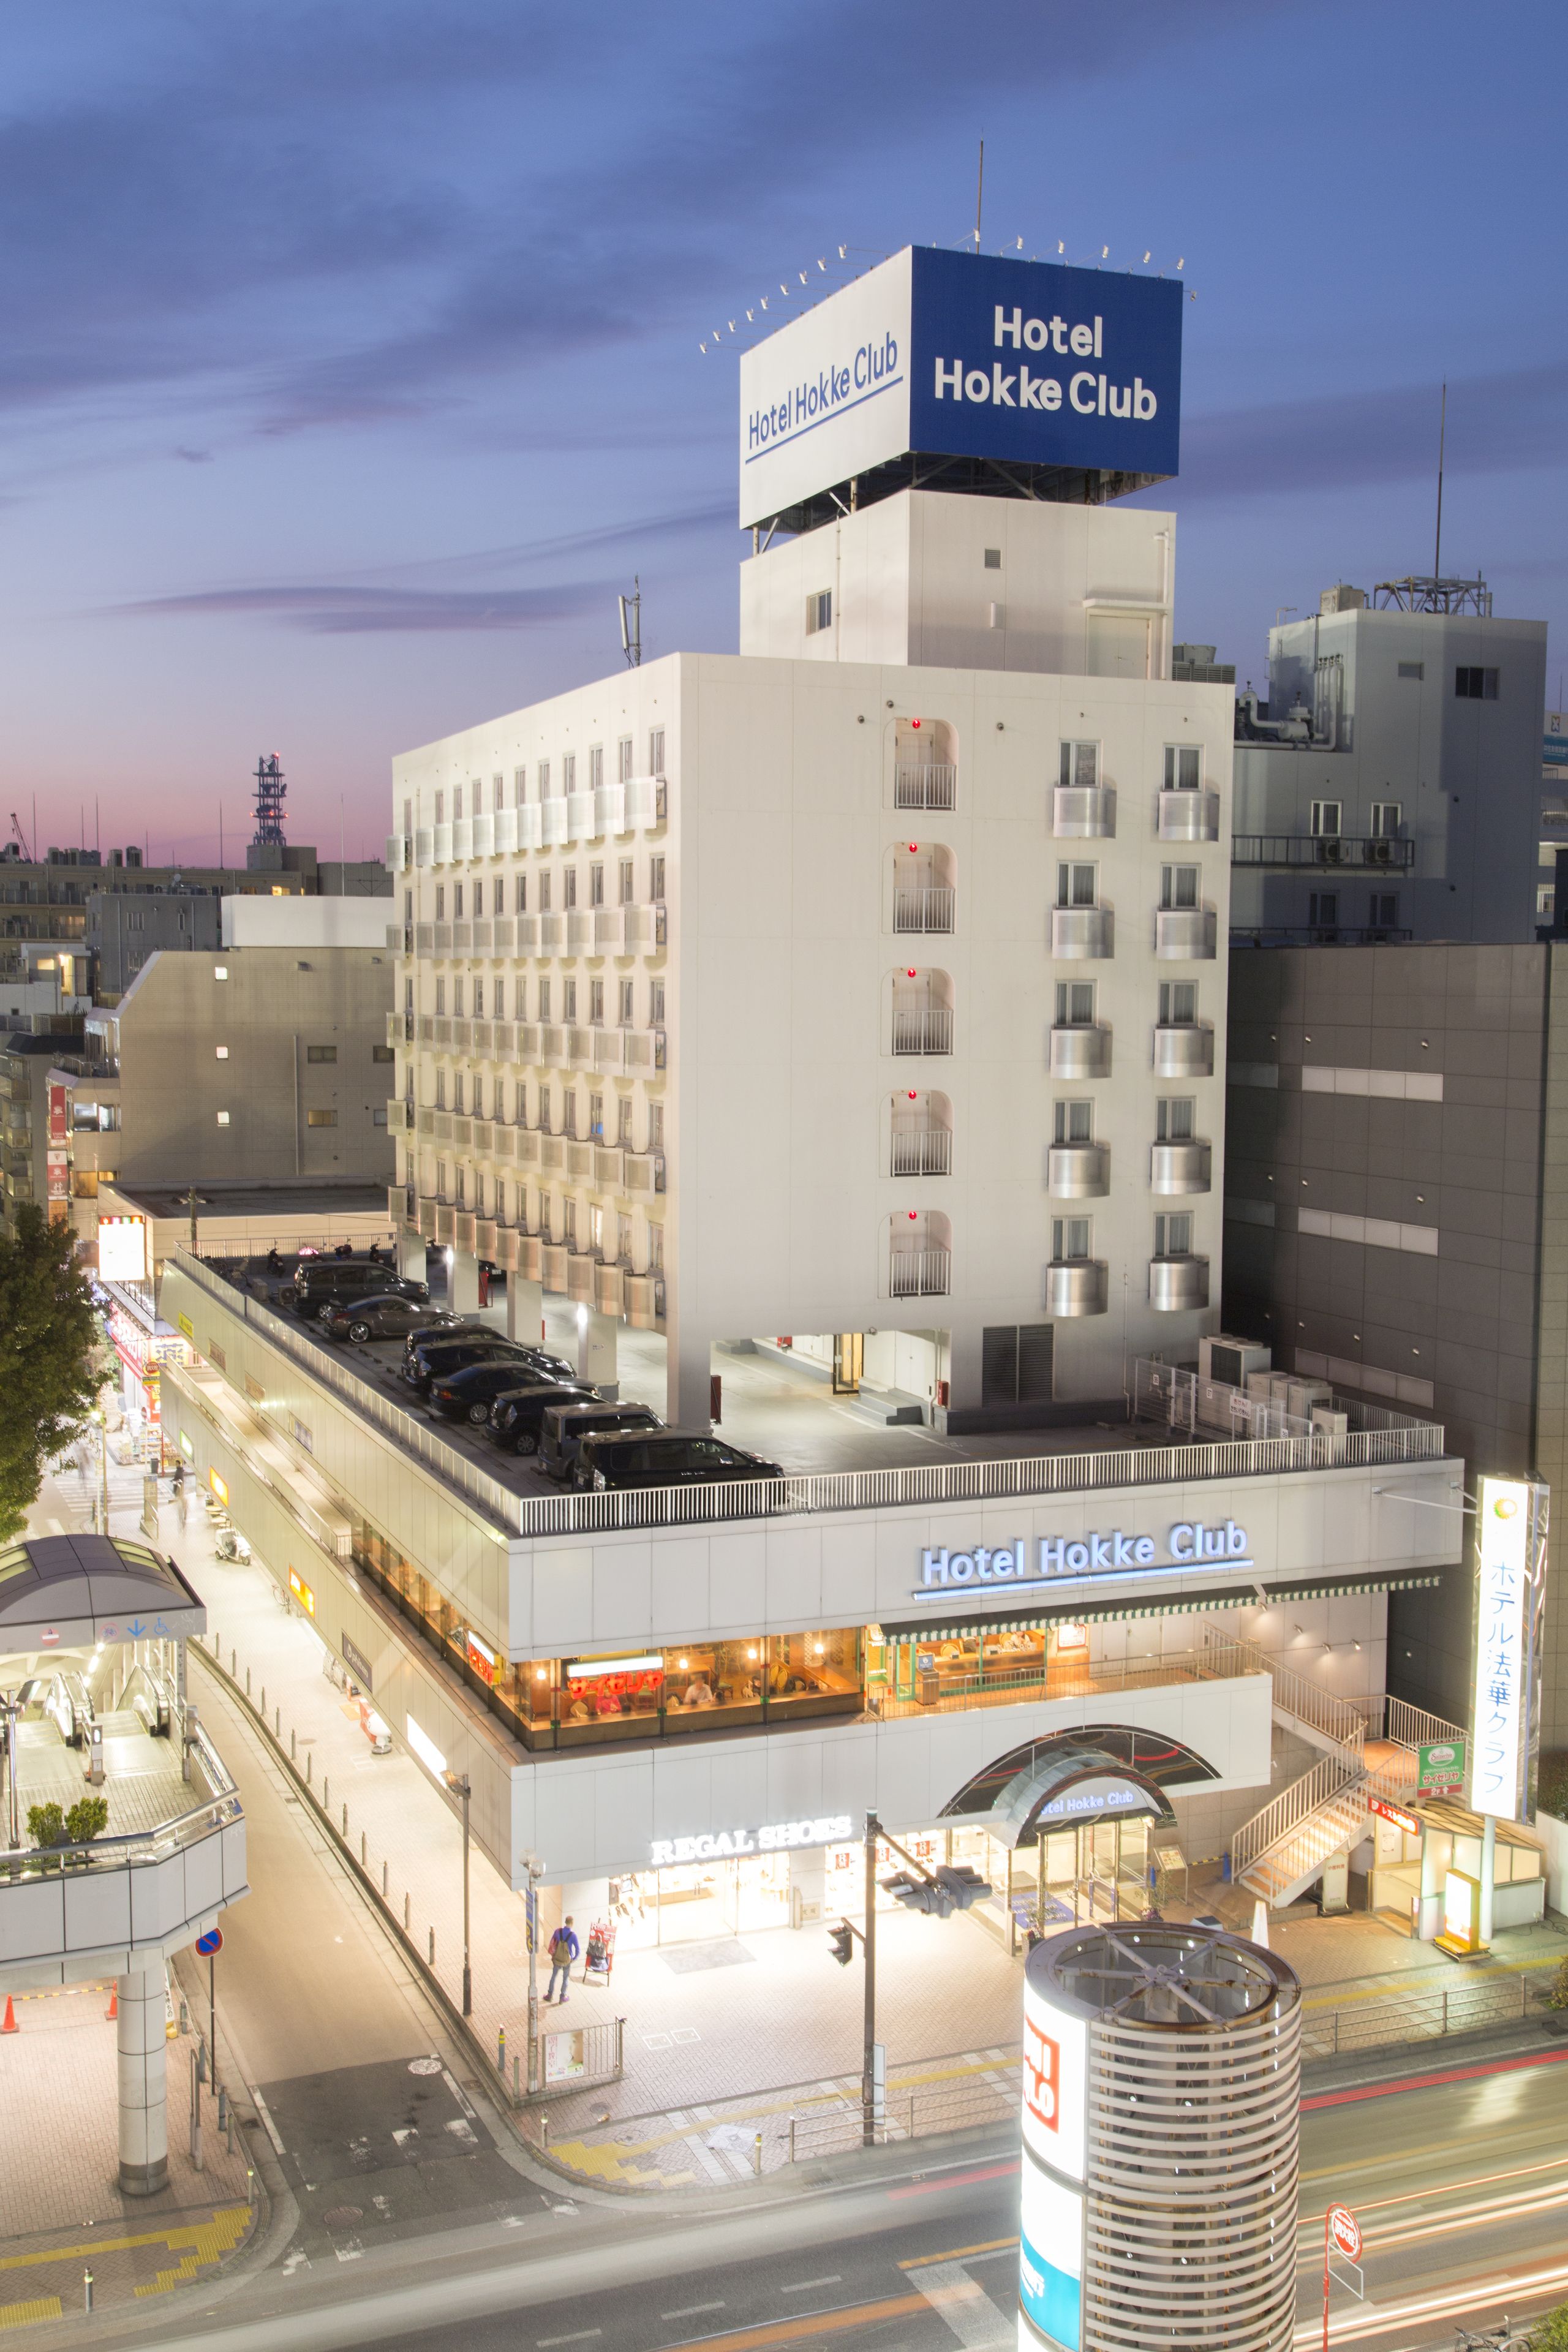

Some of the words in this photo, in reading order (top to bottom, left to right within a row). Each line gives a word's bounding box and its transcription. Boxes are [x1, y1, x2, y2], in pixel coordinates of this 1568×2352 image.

[994, 305, 1102, 358] Hotel
[748, 391, 792, 450] Hotel
[796, 364, 850, 424] Hokke
[854, 331, 897, 390] Club
[935, 357, 1063, 411] Hokke
[1069, 372, 1157, 420] Club
[922, 1538, 1025, 1586] Hotel
[1040, 1531, 1155, 1574] Hokke
[1169, 1520, 1248, 1560] Club
[567, 1670, 663, 1700] サイゼリヤ
[1484, 1561, 1515, 1793] ホテル法華クラブ
[1041, 1800, 1064, 1815] otel
[1067, 1795, 1104, 1812] Hokke
[1107, 1790, 1134, 1806] Club
[1423, 1772, 1460, 1785] サイゼリヤ
[1431, 1787, 1441, 1796] 2F
[651, 1830, 753, 1864] REGAL
[758, 1815, 852, 1850] SHOES
